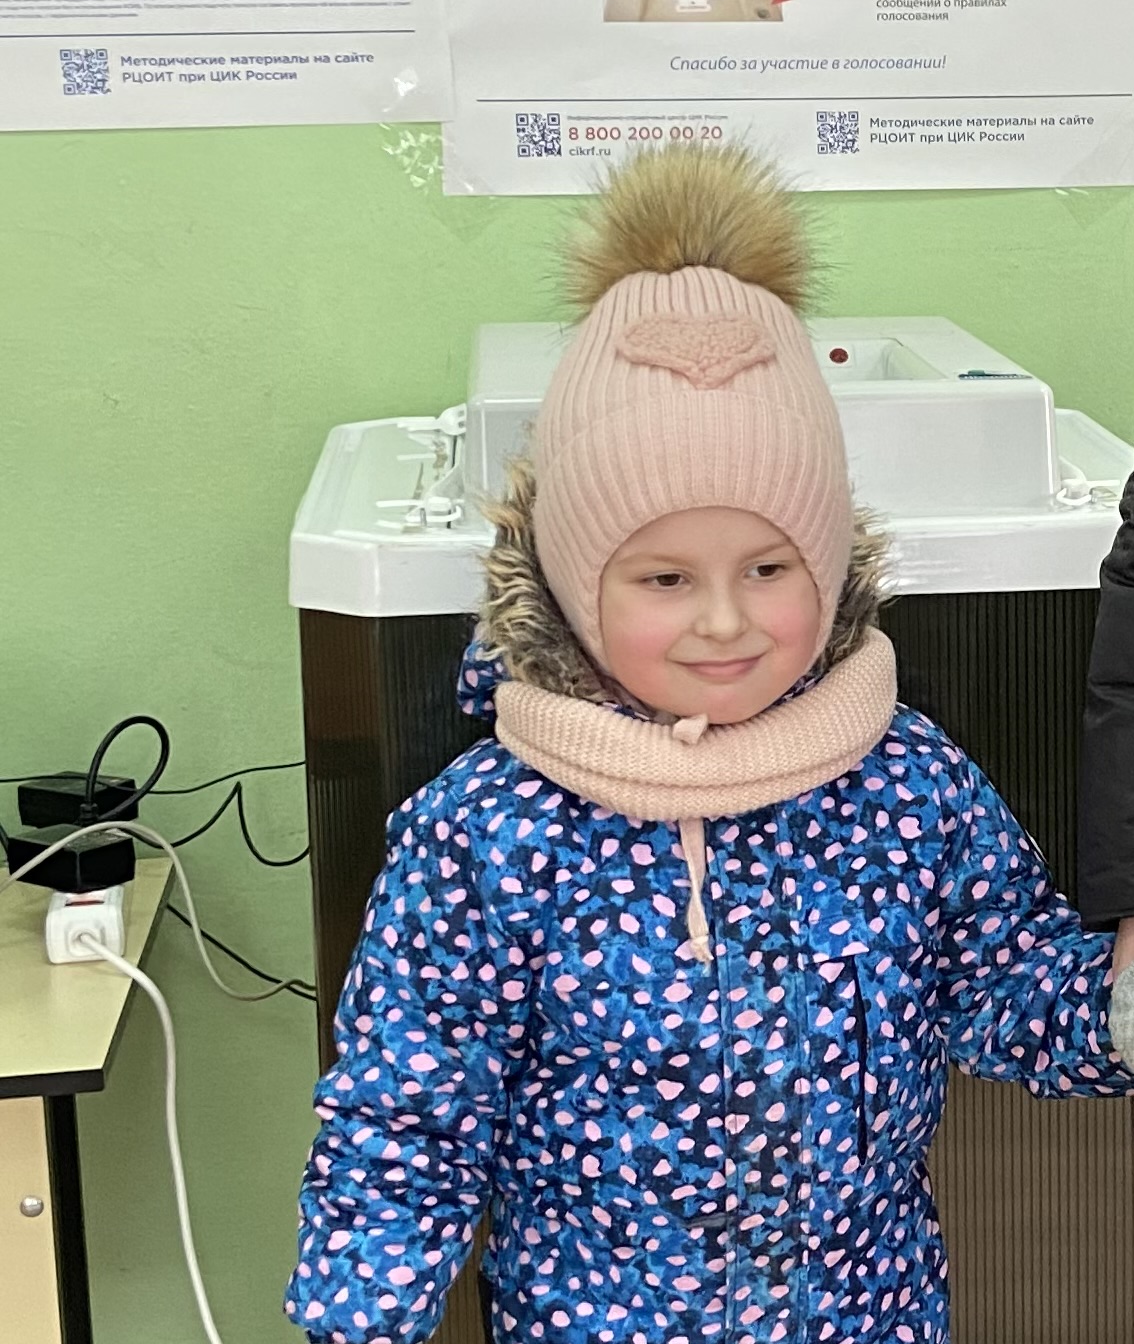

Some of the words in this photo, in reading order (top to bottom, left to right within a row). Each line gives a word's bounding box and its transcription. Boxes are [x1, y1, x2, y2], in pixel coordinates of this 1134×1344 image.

[944, 0, 951, 8] о
[954, 0, 1007, 9] правилах
[876, 12, 948, 21] голосования
[121, 55, 225, 68] Методические
[230, 54, 309, 65] материалы
[314, 54, 330, 63] на
[334, 51, 374, 63] сайте
[670, 56, 737, 71] Спасибо
[740, 59, 758, 71] за
[761, 58, 828, 73] участие
[832, 59, 840, 70] в
[843, 56, 946, 71] голосовании!
[122, 71, 173, 84] РЦОИТ
[179, 72, 206, 85] при
[209, 71, 242, 83] ЦИК
[246, 70, 297, 81] России
[869, 116, 963, 129] Методические
[967, 117, 1036, 128] материалы
[1039, 117, 1054, 126] на
[1058, 115, 1095, 126] сайте
[568, 127, 578, 140] 8
[585, 127, 621, 140] 800
[628, 126, 663, 140] 200
[670, 126, 694, 140] 00
[701, 126, 722, 139] 20
[870, 132, 915, 145] РЦОИТ
[919, 132, 944, 145] при
[947, 131, 975, 145] ЦИК
[979, 130, 1025, 142] России
[569, 147, 611, 157] cikrf.ru
